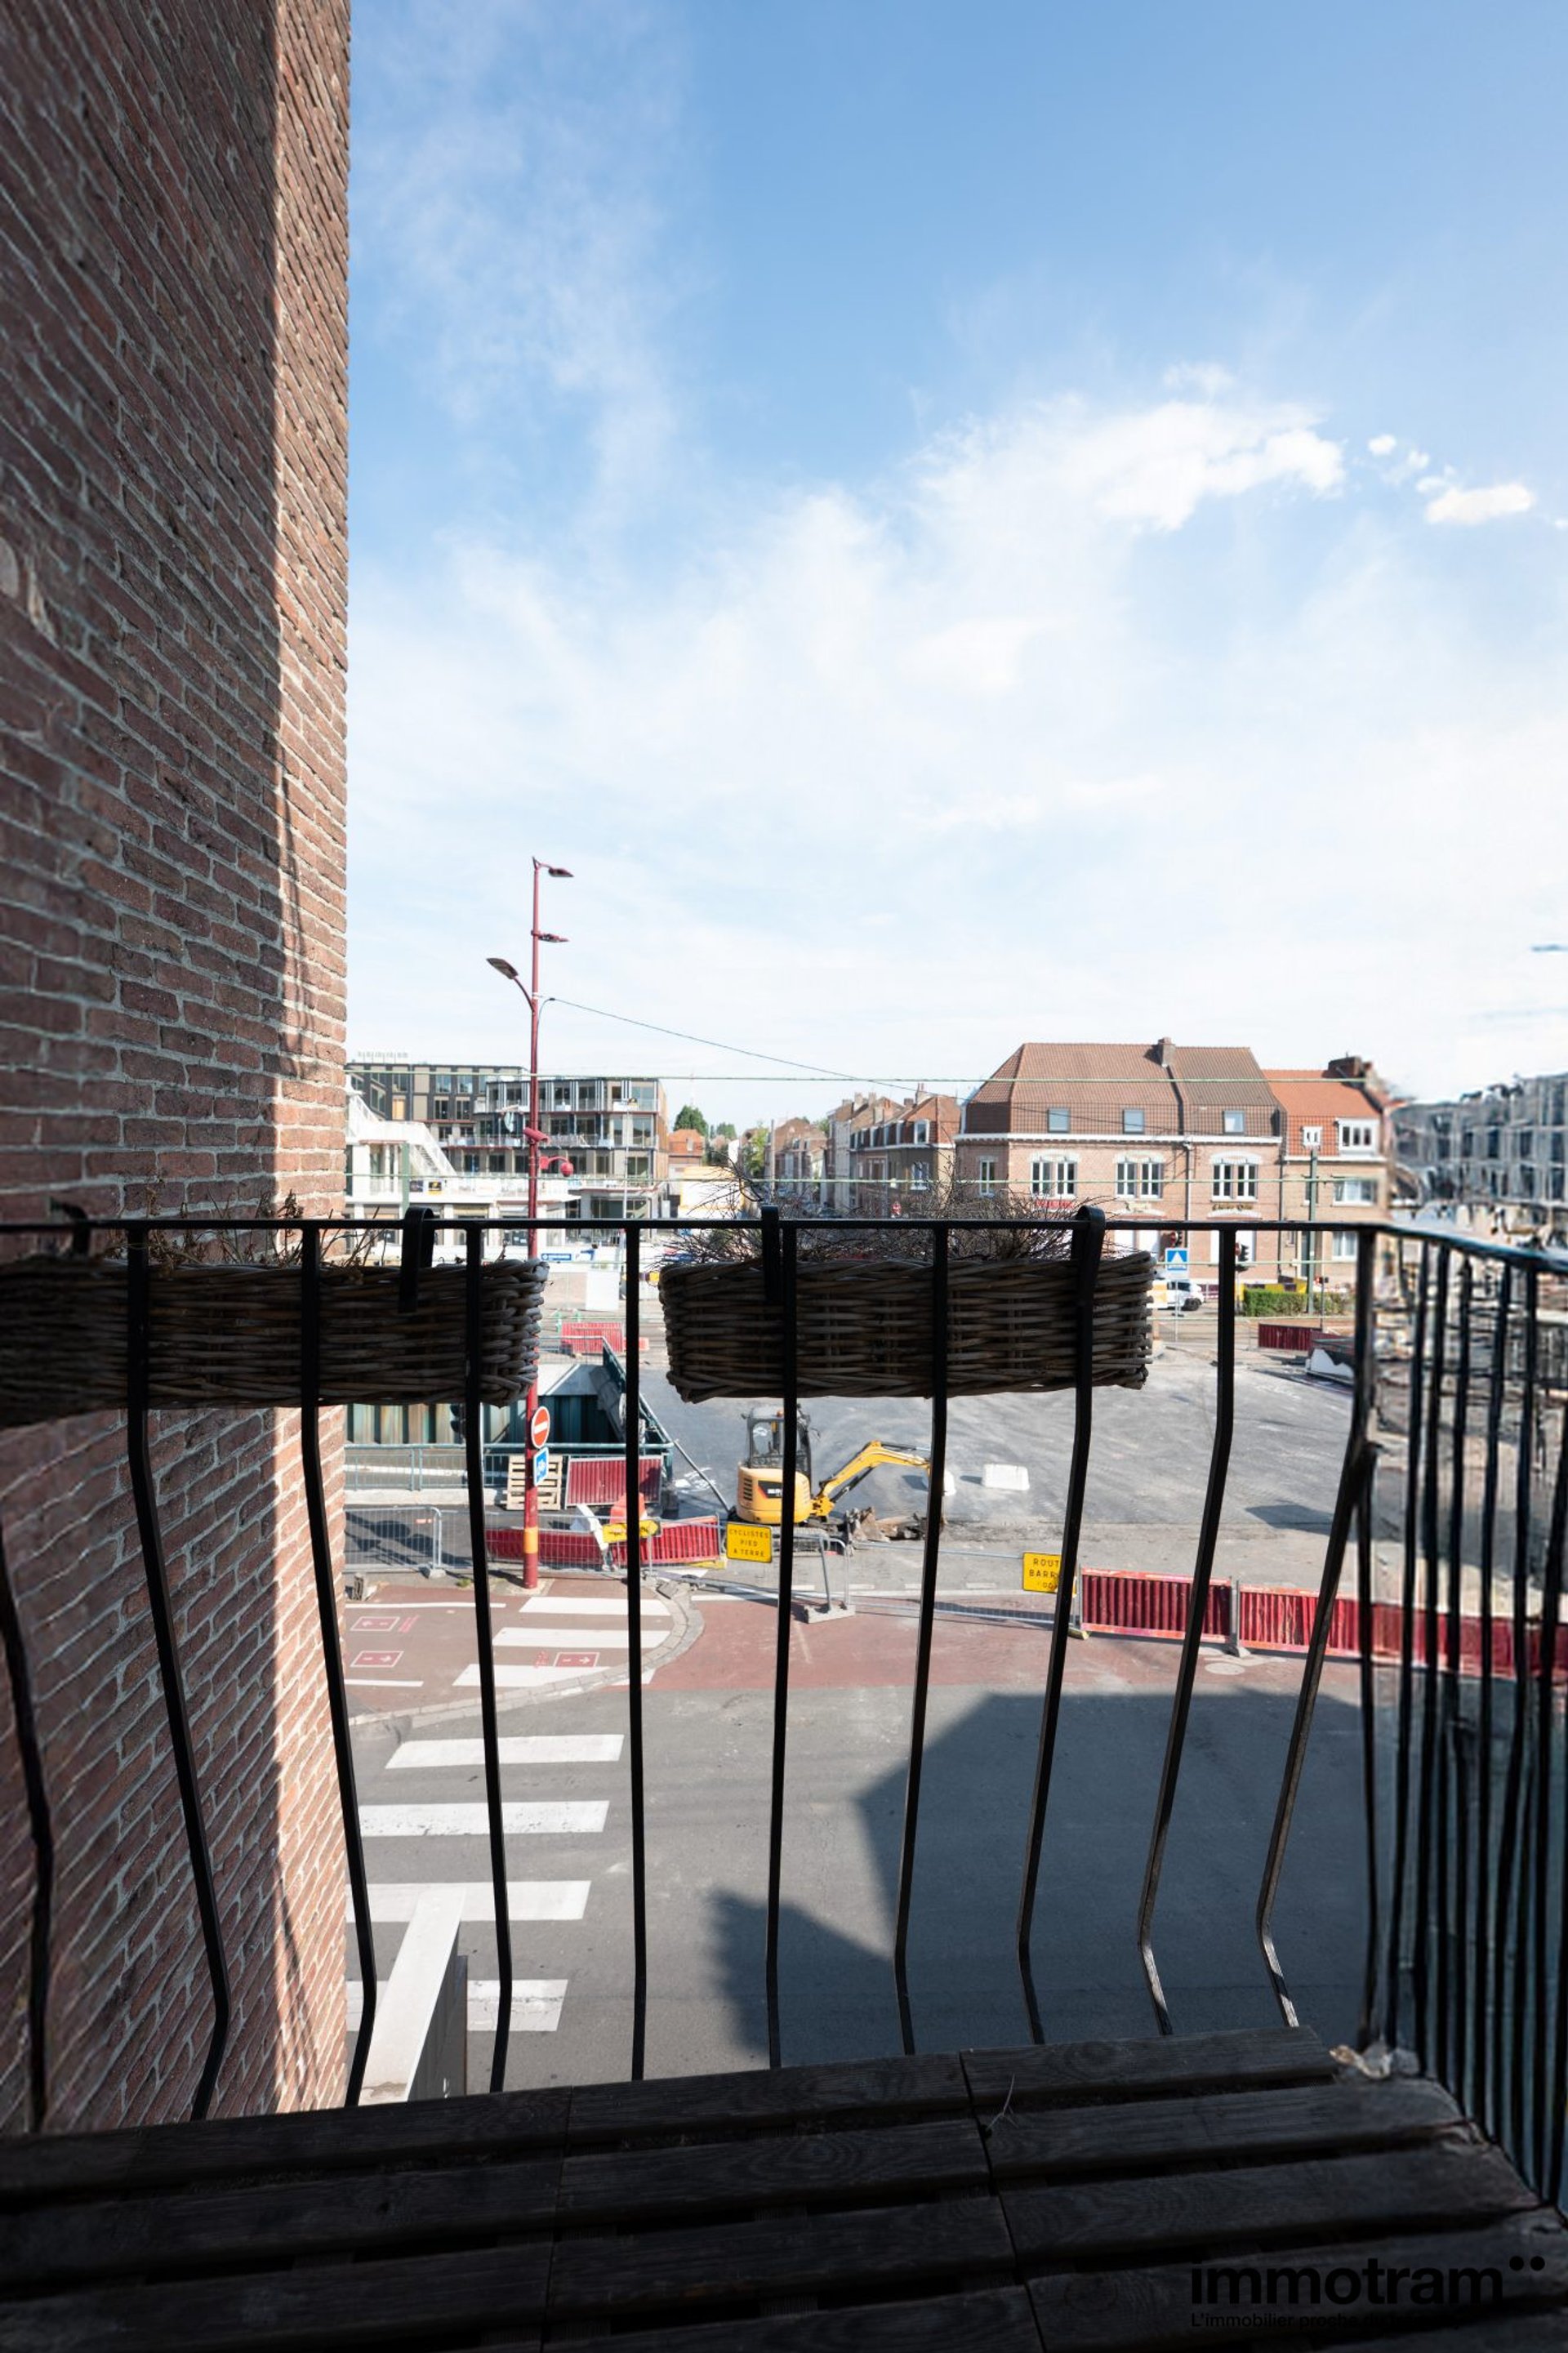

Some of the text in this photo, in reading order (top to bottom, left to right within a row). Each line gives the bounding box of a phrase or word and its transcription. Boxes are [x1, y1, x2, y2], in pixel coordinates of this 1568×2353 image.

[728, 1529, 769, 1539] CYCLISTES
[740, 1539, 758, 1547] PIED
[741, 1549, 764, 1557] TERRE
[1033, 1558, 1059, 1568] ROUT
[1029, 1569, 1055, 1578] BARR
